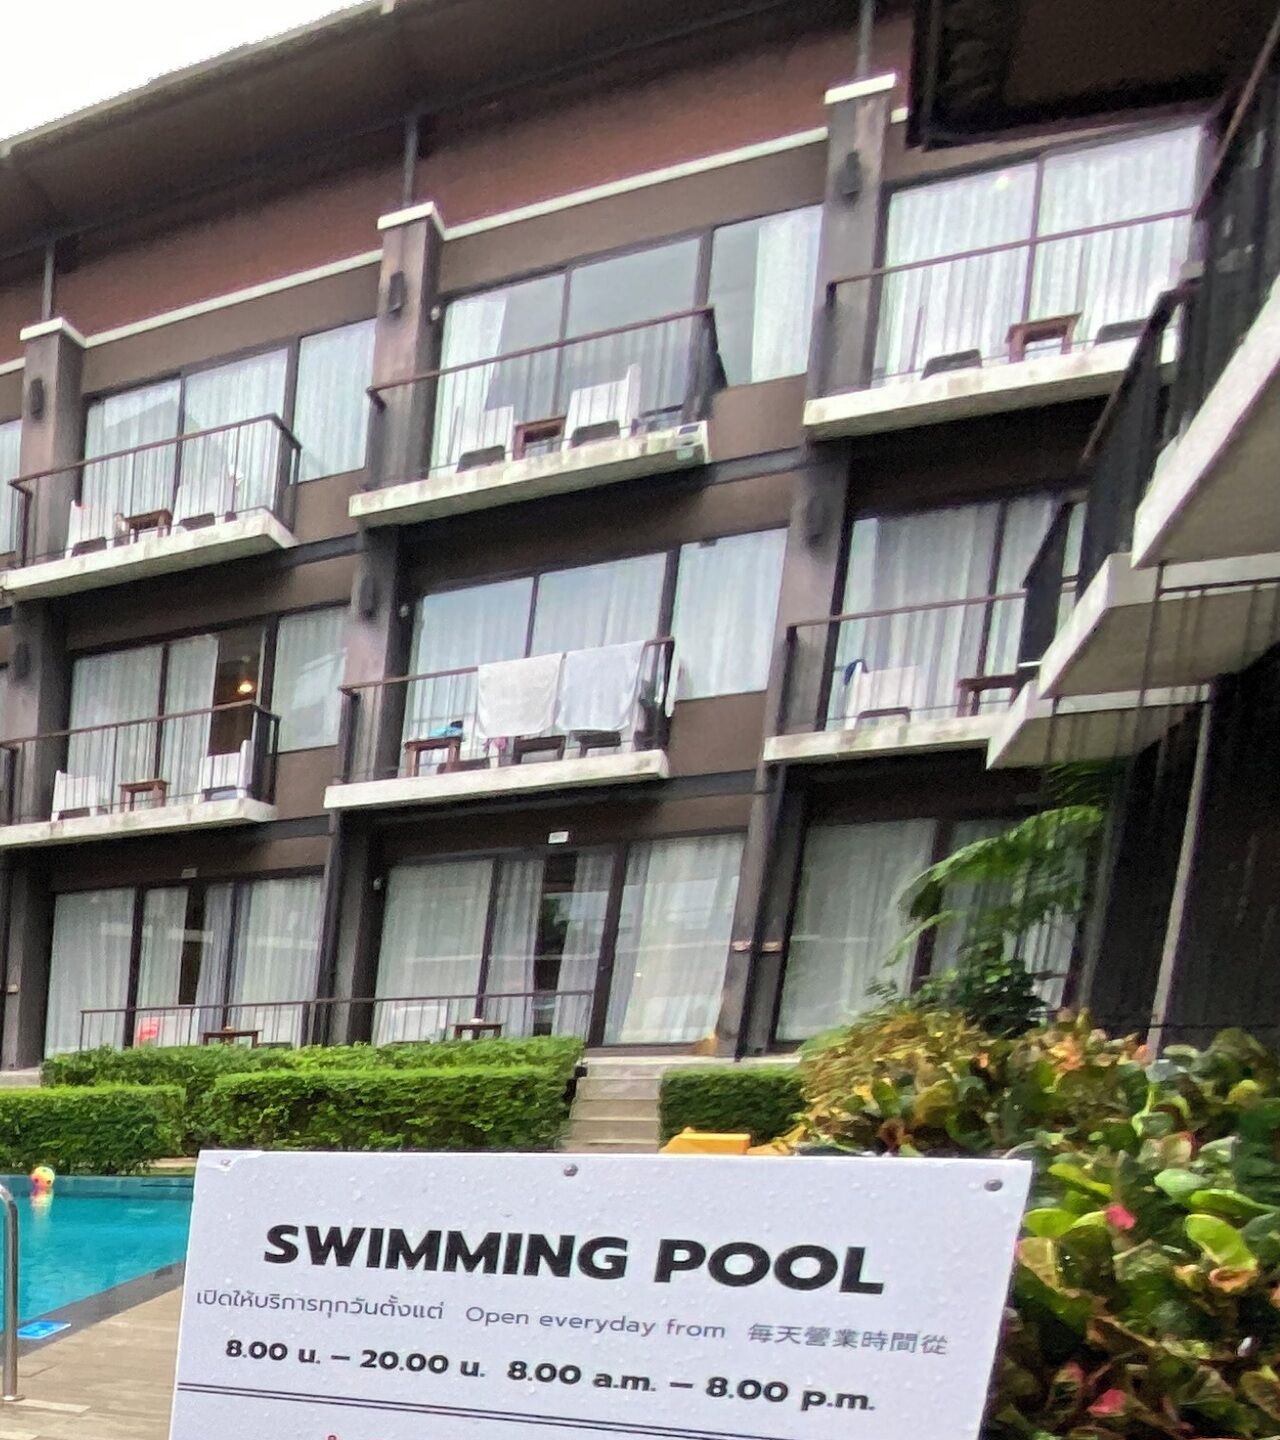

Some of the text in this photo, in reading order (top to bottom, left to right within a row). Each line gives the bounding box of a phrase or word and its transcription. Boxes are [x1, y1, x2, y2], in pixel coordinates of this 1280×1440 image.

[263, 1224, 884, 1295] SWIMMING POOL
[465, 1306, 530, 1327] Open
[539, 1315, 656, 1338] everyday
[666, 1318, 726, 1338] from
[748, 1323, 948, 1355] 每天營業時間從
[225, 1339, 288, 1361] 8.00
[359, 1349, 450, 1375] 20.00
[507, 1360, 582, 1385] 8.00
[592, 1373, 656, 1392] a.m.
[705, 1376, 789, 1403] 8.00
[800, 1390, 875, 1412] p.m.
